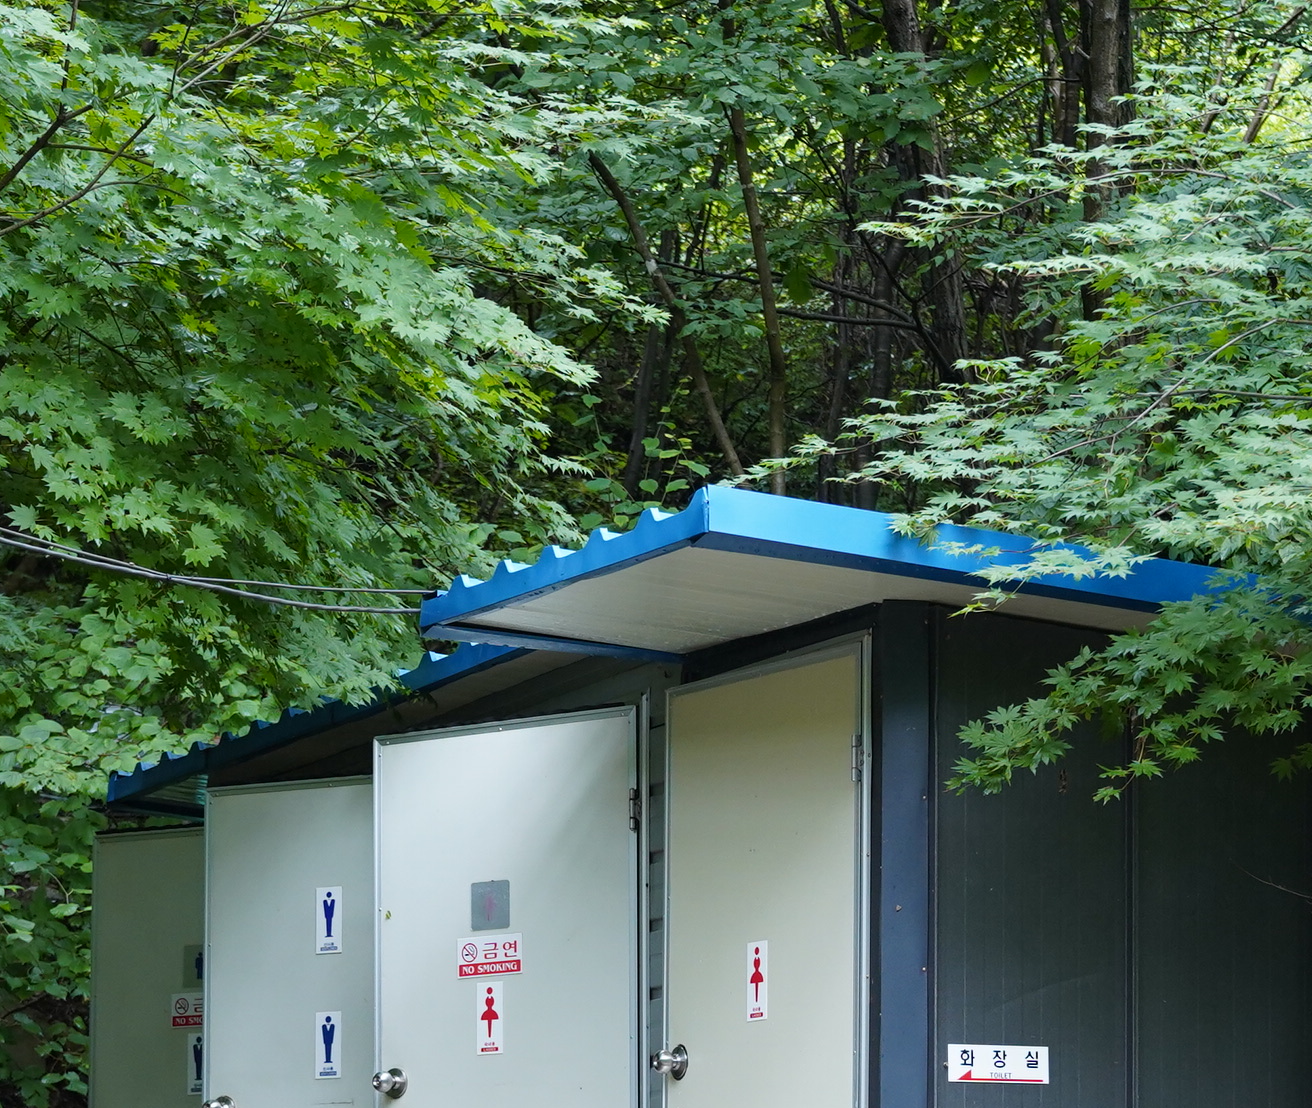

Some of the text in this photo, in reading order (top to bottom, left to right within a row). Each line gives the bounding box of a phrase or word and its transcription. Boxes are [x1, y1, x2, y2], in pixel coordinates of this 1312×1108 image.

[482, 940, 517, 960] 금연
[462, 962, 517, 975] NO SMOKING
[174, 1017, 186, 1025] NO
[990, 1072, 1012, 1080] TOILET
